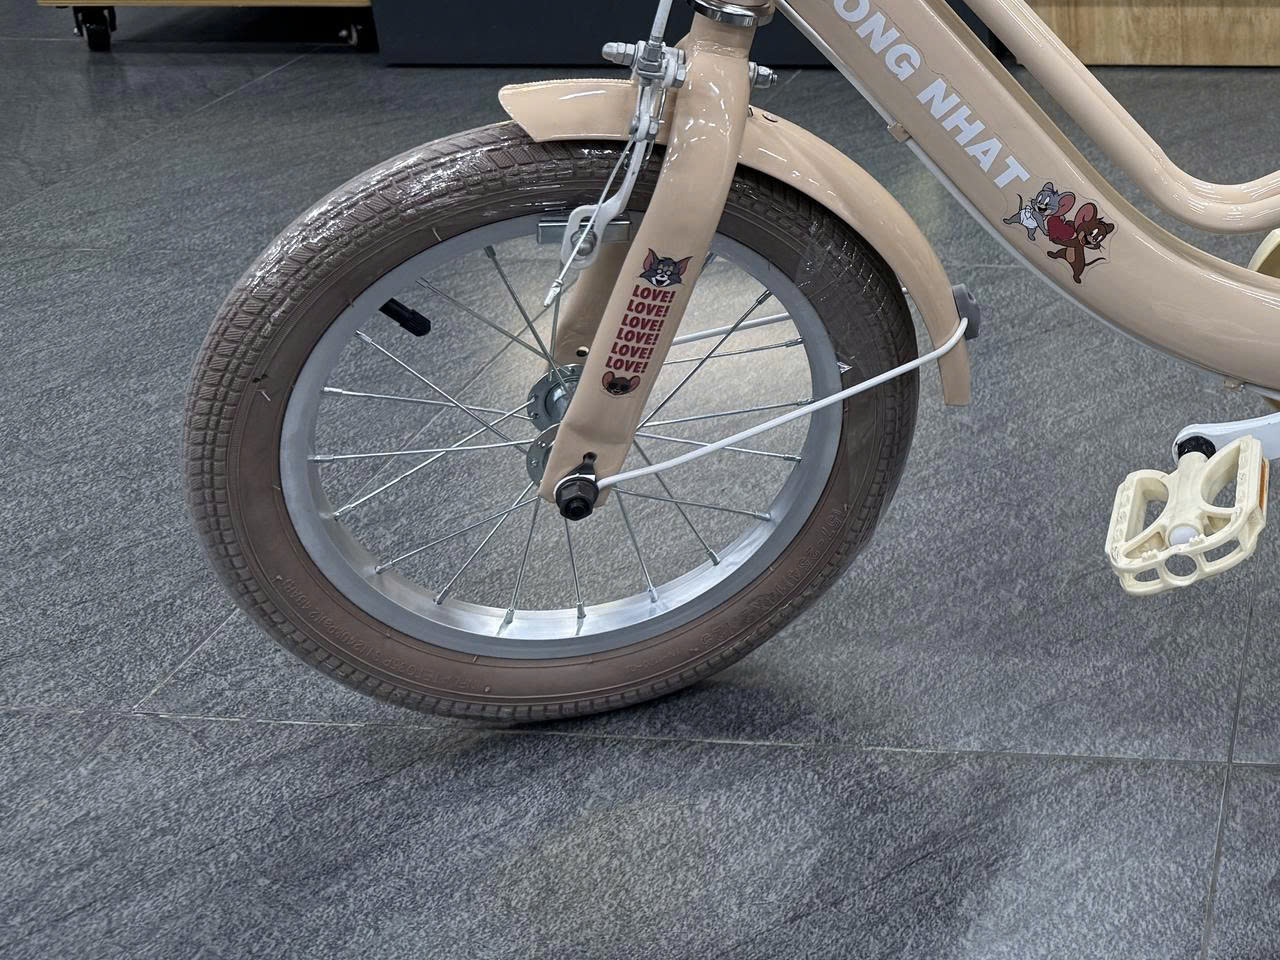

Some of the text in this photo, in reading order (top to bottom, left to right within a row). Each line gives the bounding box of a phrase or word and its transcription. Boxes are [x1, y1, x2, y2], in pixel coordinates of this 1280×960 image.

[916, 78, 1031, 189] NHAT
[632, 284, 676, 303] LOVE!
[627, 299, 670, 318] LOVE!
[621, 314, 664, 332] LOVE!
[616, 328, 659, 345] LOVE!
[611, 342, 654, 359] LOVE!
[605, 356, 648, 373] LOVE!
